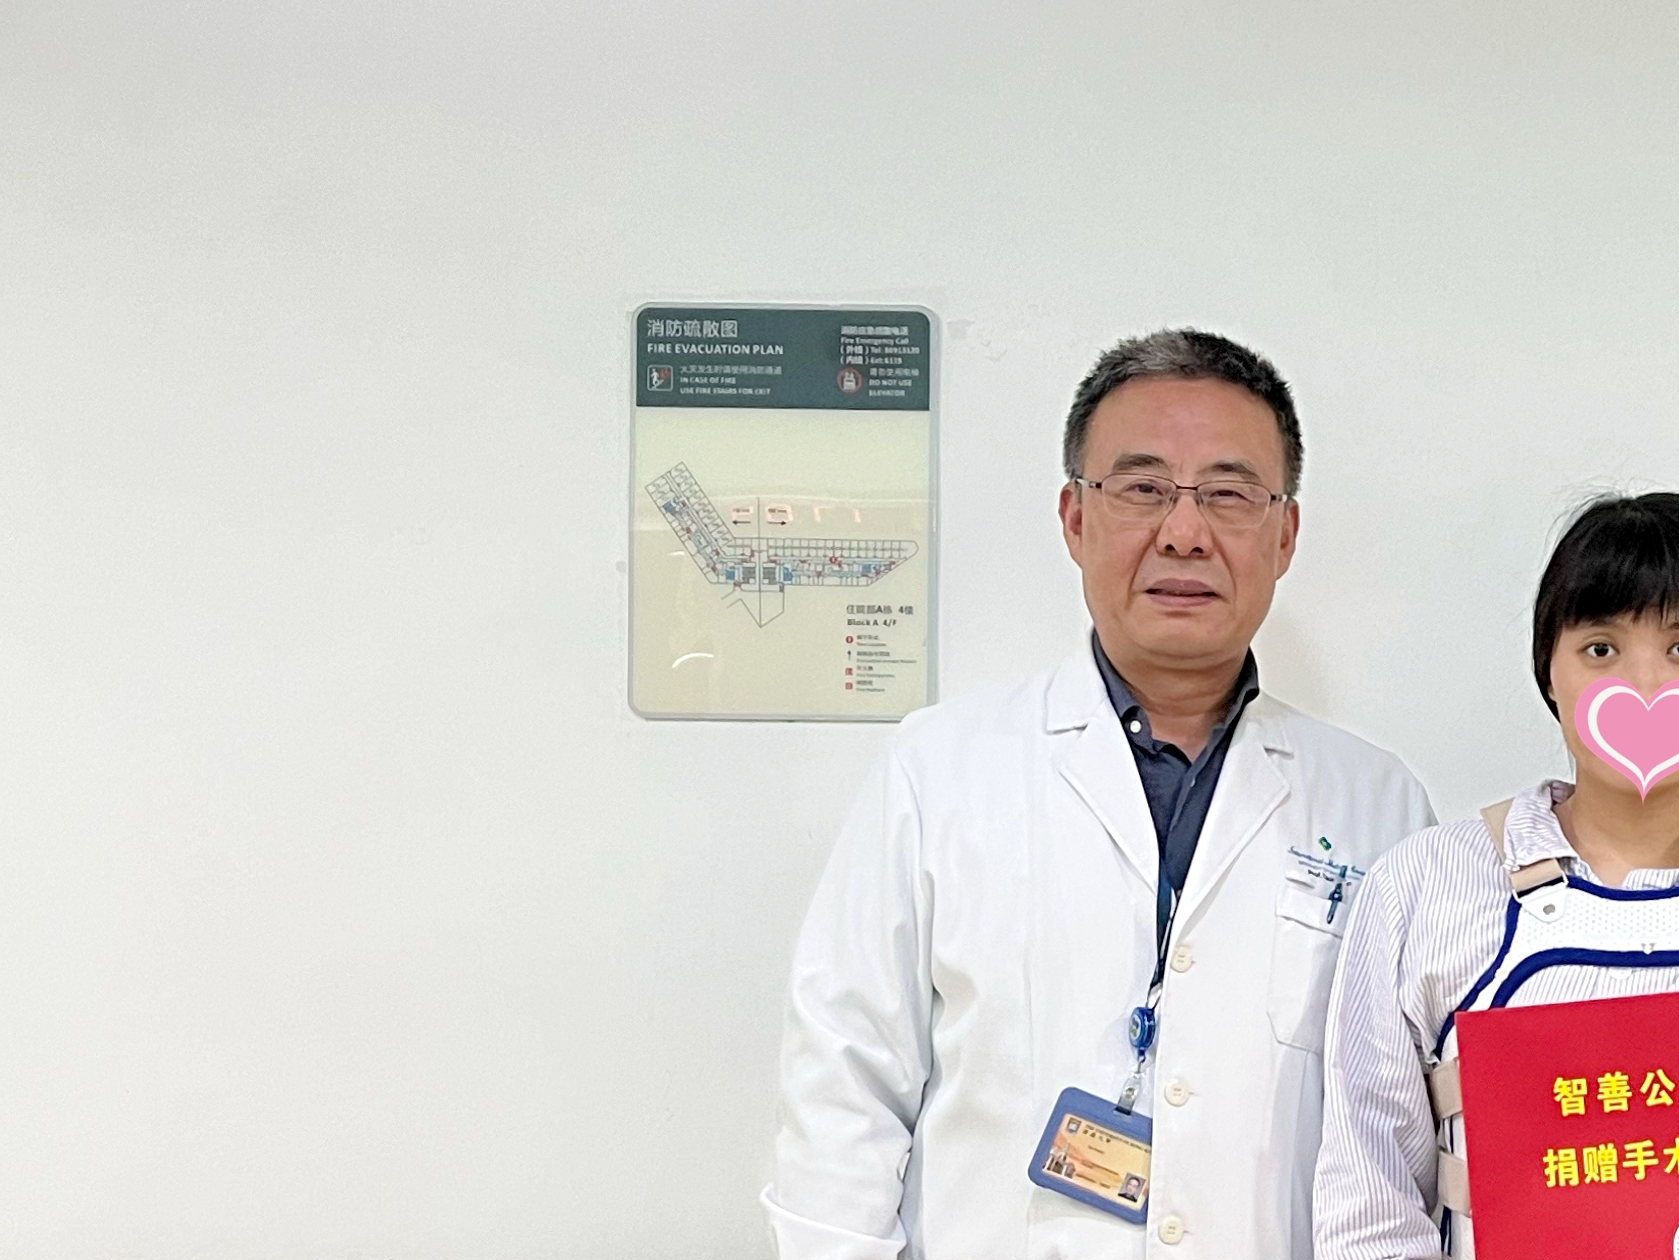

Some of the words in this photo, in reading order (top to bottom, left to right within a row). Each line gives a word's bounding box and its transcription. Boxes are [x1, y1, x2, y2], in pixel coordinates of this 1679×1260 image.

[647, 319, 738, 338] 消防疏散图
[647, 343, 672, 354] FIRE
[675, 343, 750, 355] EVACUATION
[753, 344, 784, 355] PLAN
